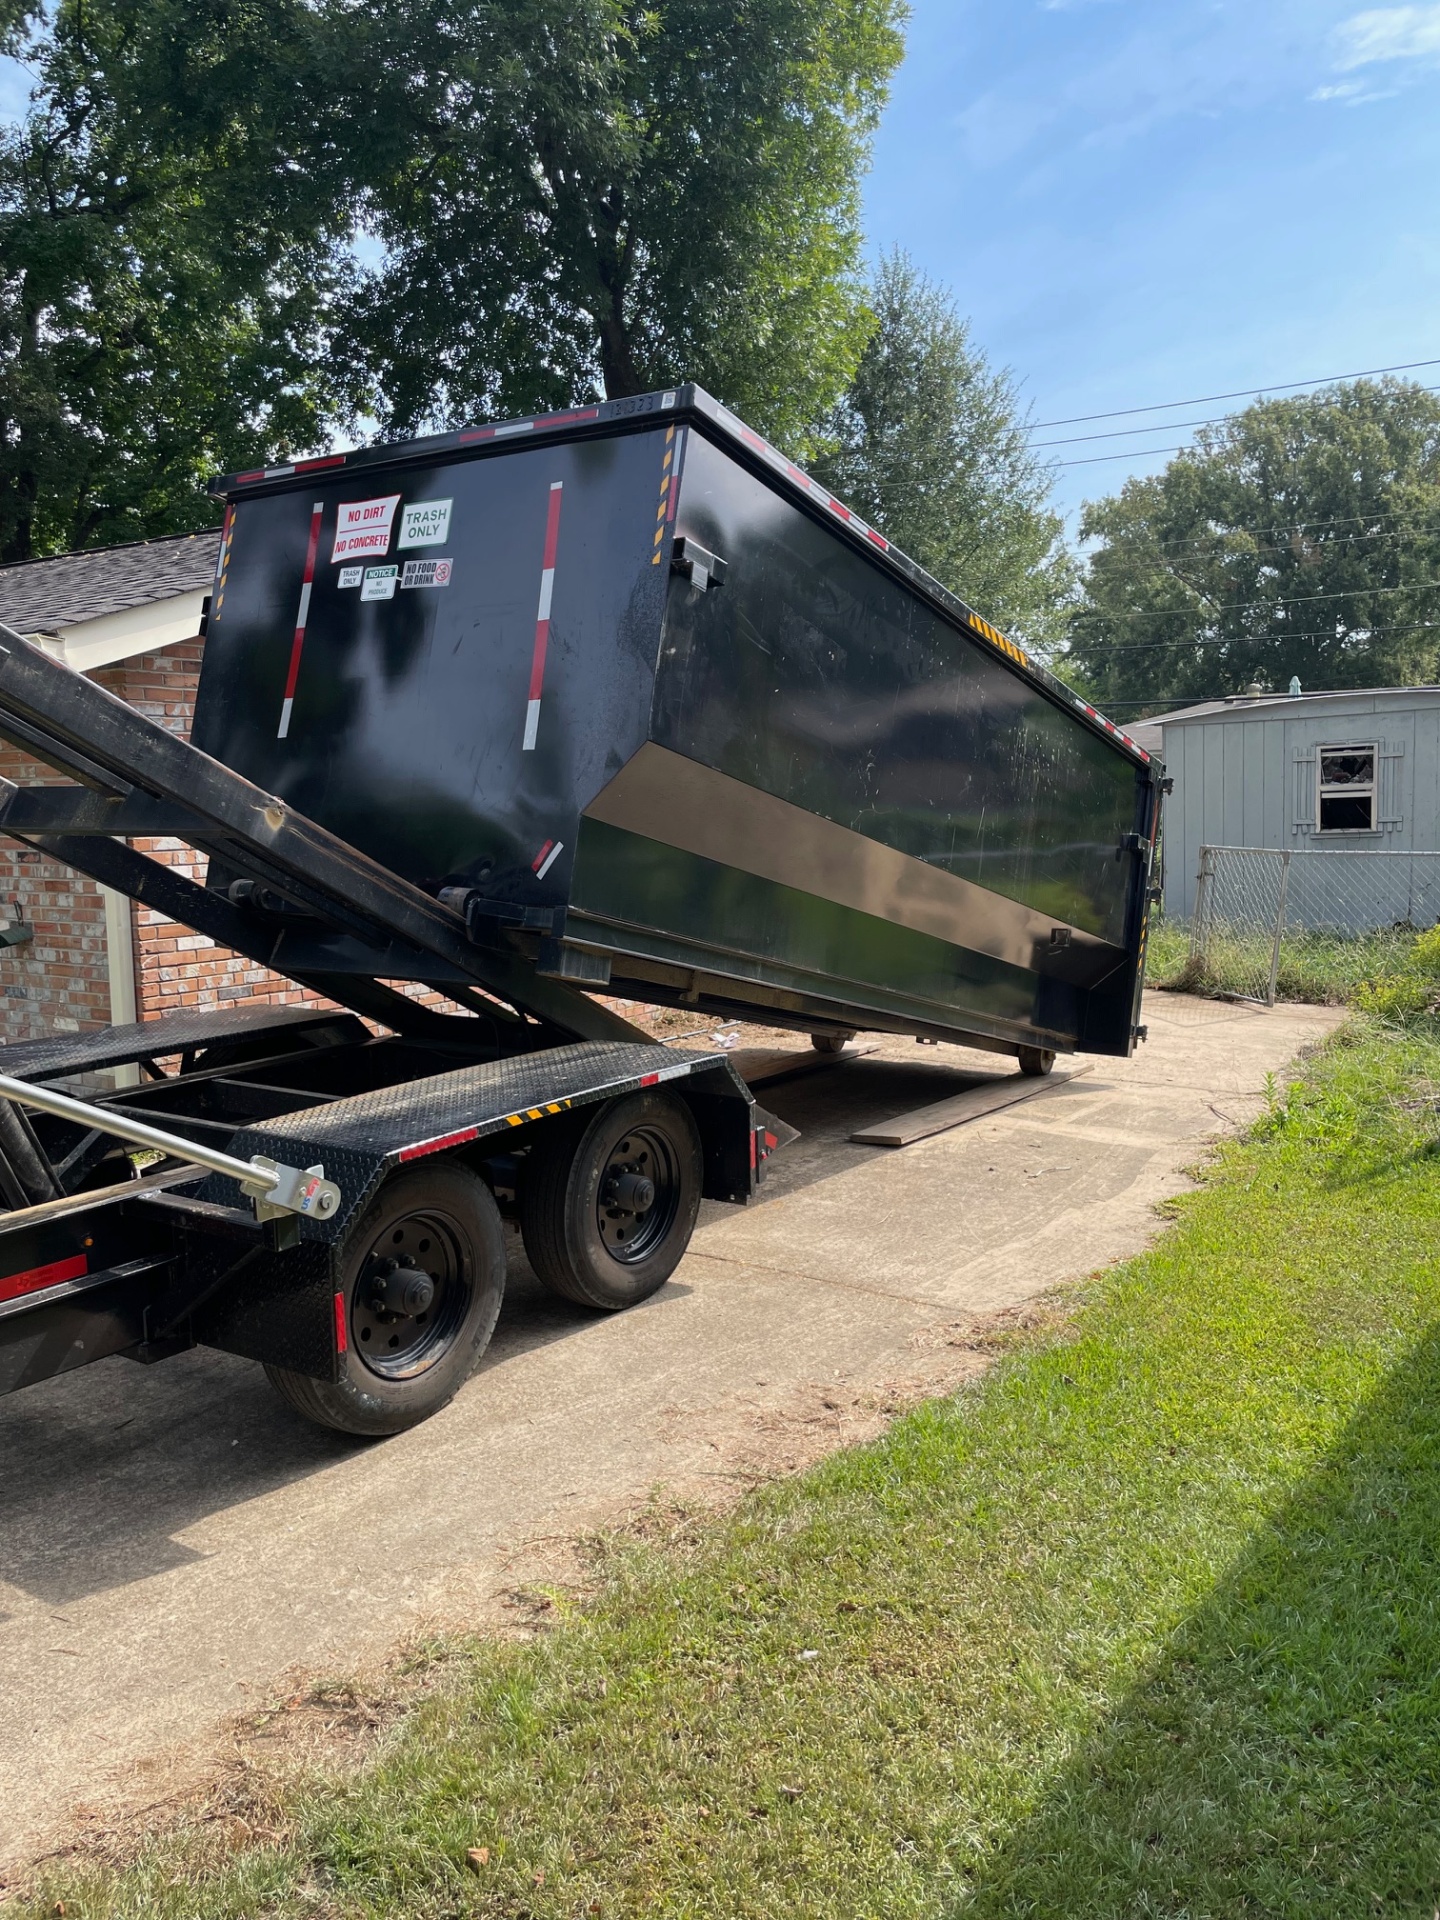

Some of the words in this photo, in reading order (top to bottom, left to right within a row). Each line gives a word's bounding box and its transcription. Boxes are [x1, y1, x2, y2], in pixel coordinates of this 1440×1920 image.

[348, 510, 361, 522] NO
[363, 505, 386, 520] DIRT
[406, 508, 447, 524] TRASH
[408, 525, 440, 538] ONLY
[335, 541, 346, 554] NO
[348, 534, 388, 550] CONCRETE
[343, 569, 360, 578] TRASH
[406, 563, 417, 573] NO
[417, 562, 437, 573] FOOD
[369, 570, 393, 579] NOTICE
[404, 575, 413, 586] OR
[414, 574, 435, 585] DRINK
[343, 577, 356, 586] ONLY
